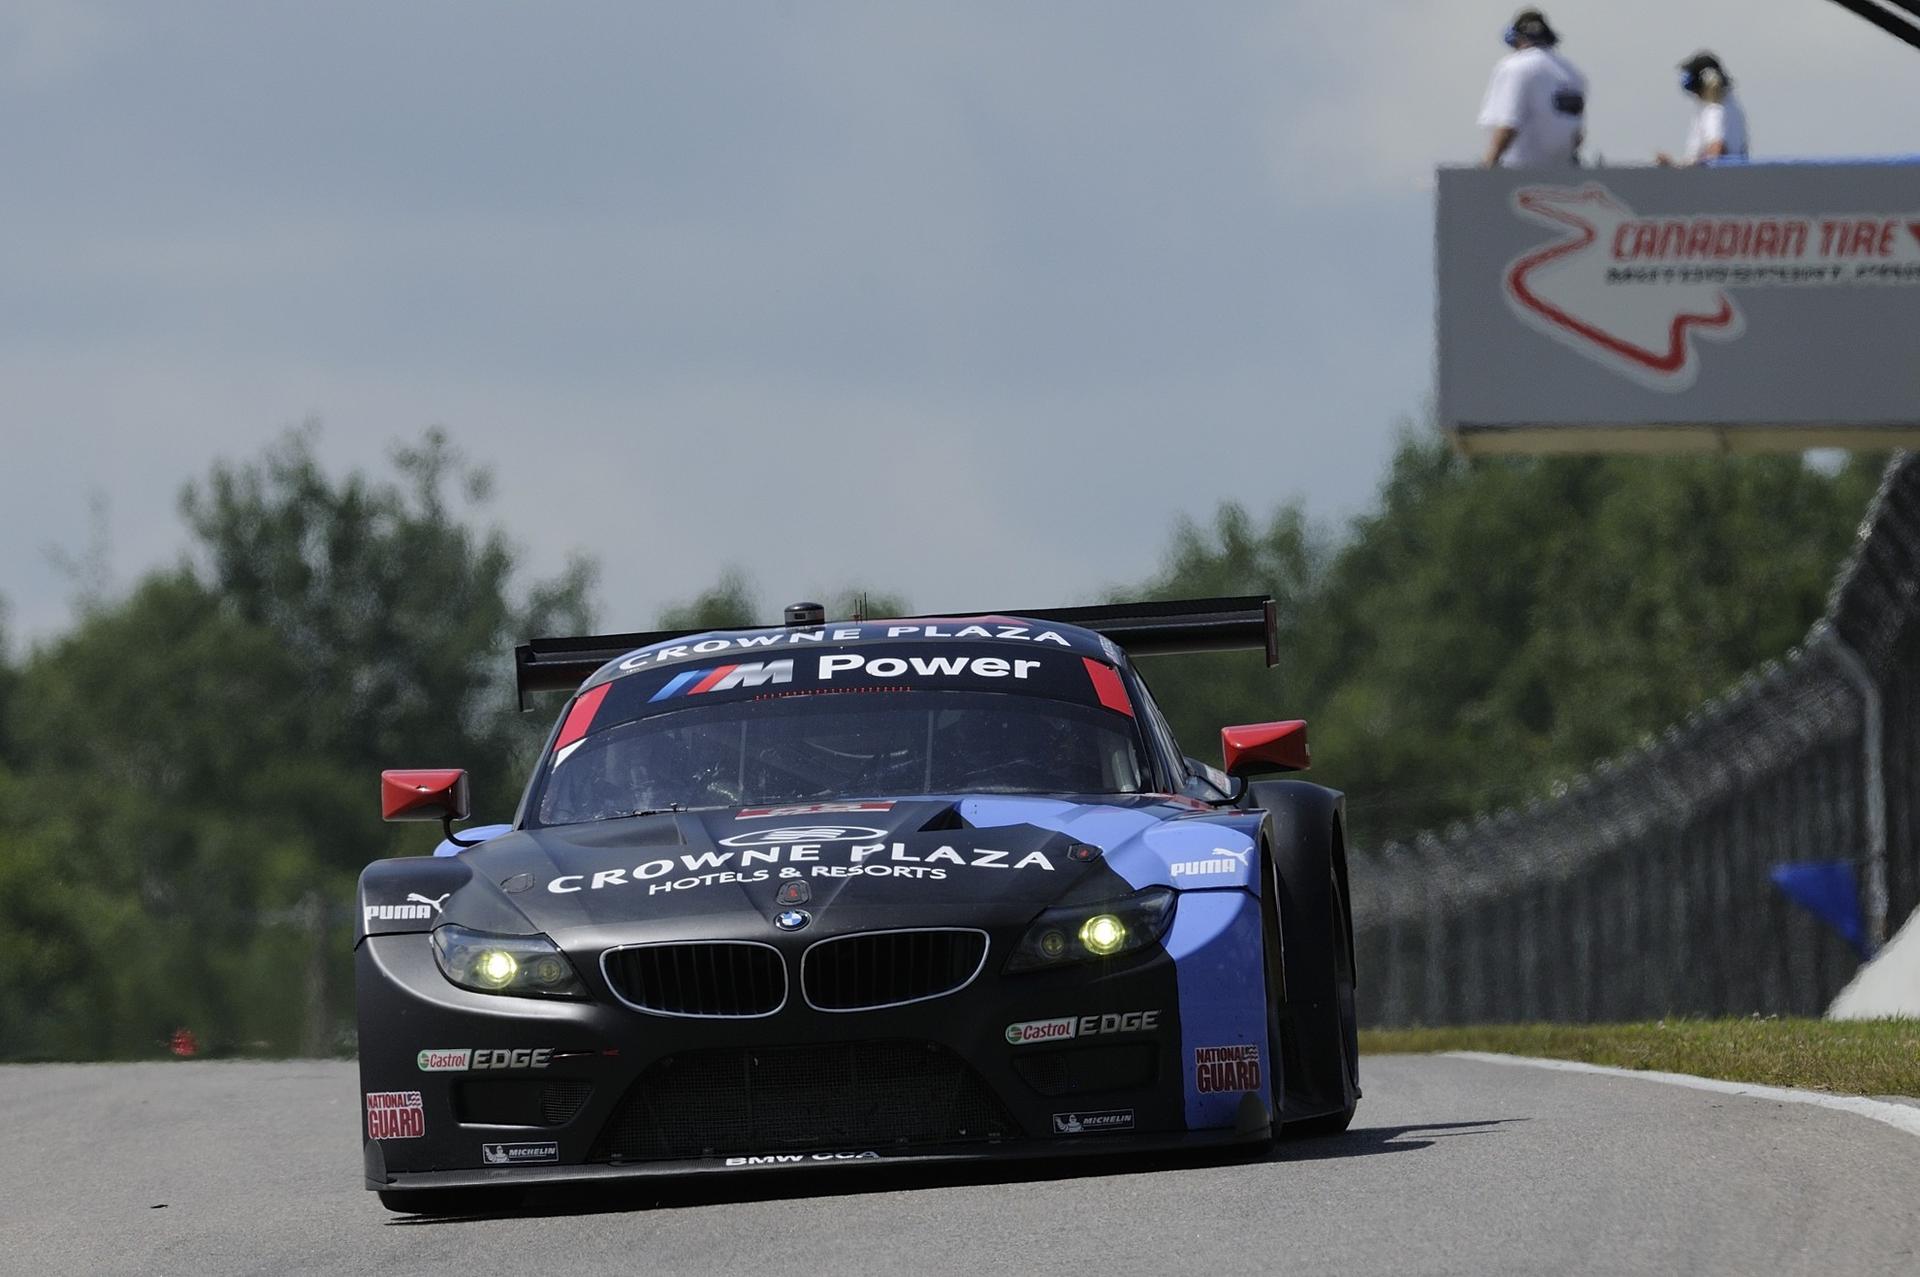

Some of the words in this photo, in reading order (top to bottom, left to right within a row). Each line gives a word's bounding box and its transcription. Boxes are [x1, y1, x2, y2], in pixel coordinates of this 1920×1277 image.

[1613, 220, 1808, 260] CANADIAN
[1818, 220, 1898, 258] TIRE
[619, 628, 861, 671] CROWNE
[887, 625, 1071, 647] PLAZA
[818, 654, 1041, 679] Power
[547, 844, 822, 894] CROWNE
[850, 843, 1055, 871] PLAZA
[1170, 858, 1236, 876] PUMA
[648, 869, 768, 896] HOTELS
[779, 867, 801, 878] &
[811, 865, 947, 880] RESORTS
[365, 904, 431, 920] PUMA
[1023, 1020, 1071, 1040] Castrol
[1078, 1012, 1160, 1036] EDGE
[429, 1052, 466, 1067] Castrol
[471, 1049, 553, 1069] EDGE
[1196, 1047, 1245, 1063] NATIONAL
[1198, 1062, 1261, 1093] GUARD
[368, 1093, 408, 1109] NATIONAL
[368, 1108, 424, 1138] GUARD
[1083, 1114, 1132, 1126] MICHELIN
[508, 1147, 556, 1157] MICHELIN
[725, 1156, 804, 1166] BMW
